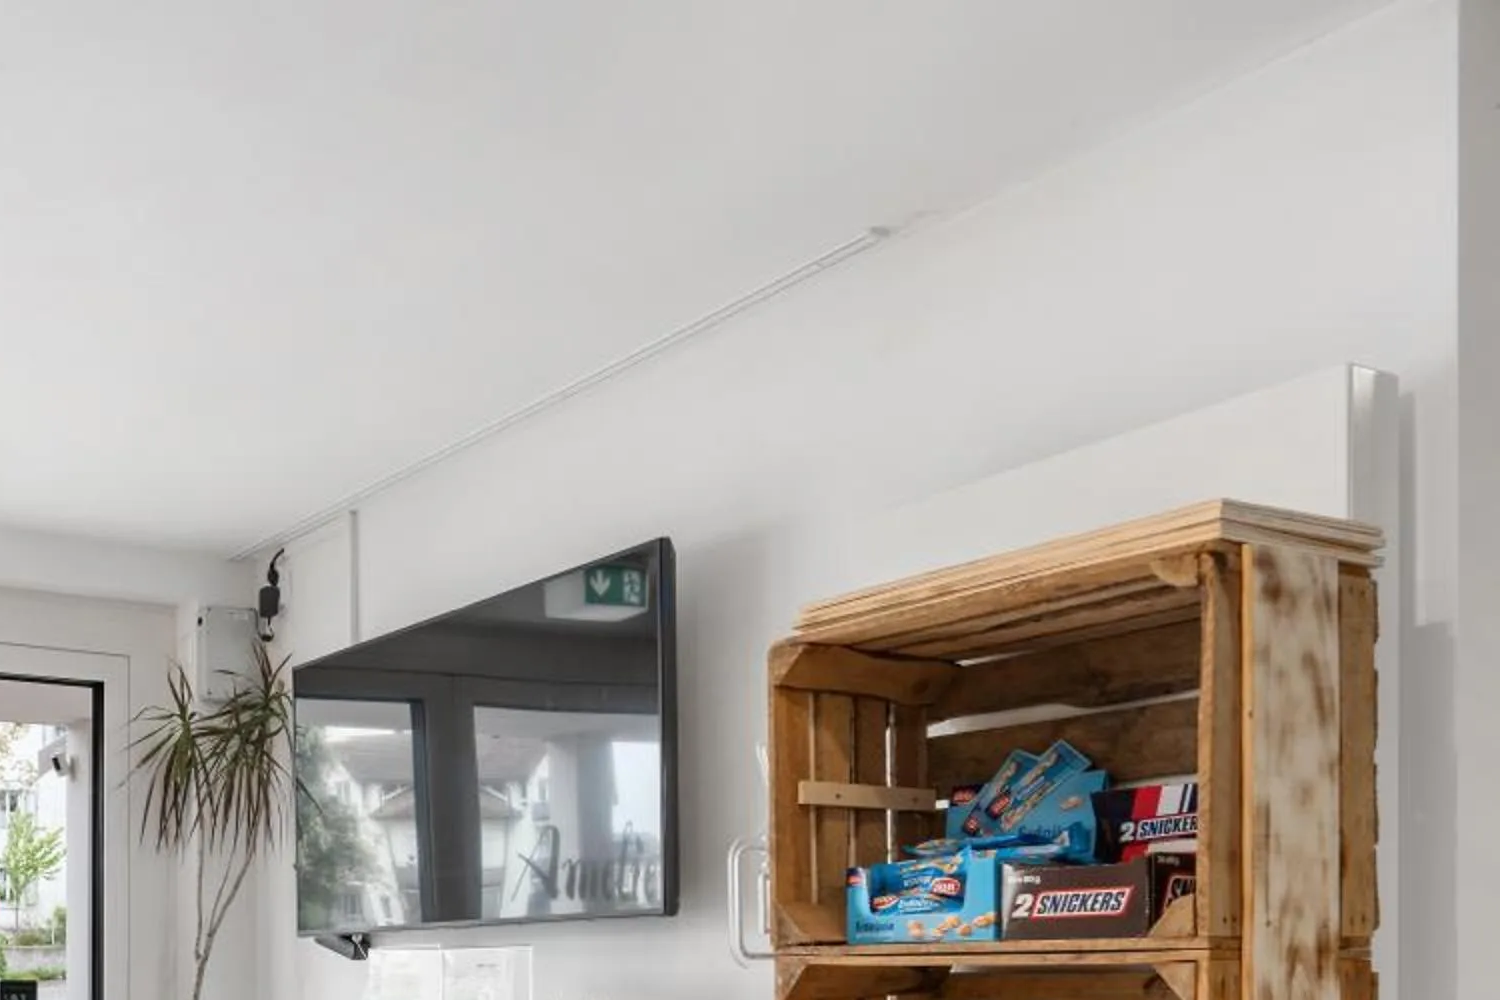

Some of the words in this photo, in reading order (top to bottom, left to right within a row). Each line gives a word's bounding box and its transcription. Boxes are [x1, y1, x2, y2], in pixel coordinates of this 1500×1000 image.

[1138, 815, 1198, 838] SNICKER
[1012, 894, 1033, 918] 2
[1038, 891, 1125, 915] SNICKERS
